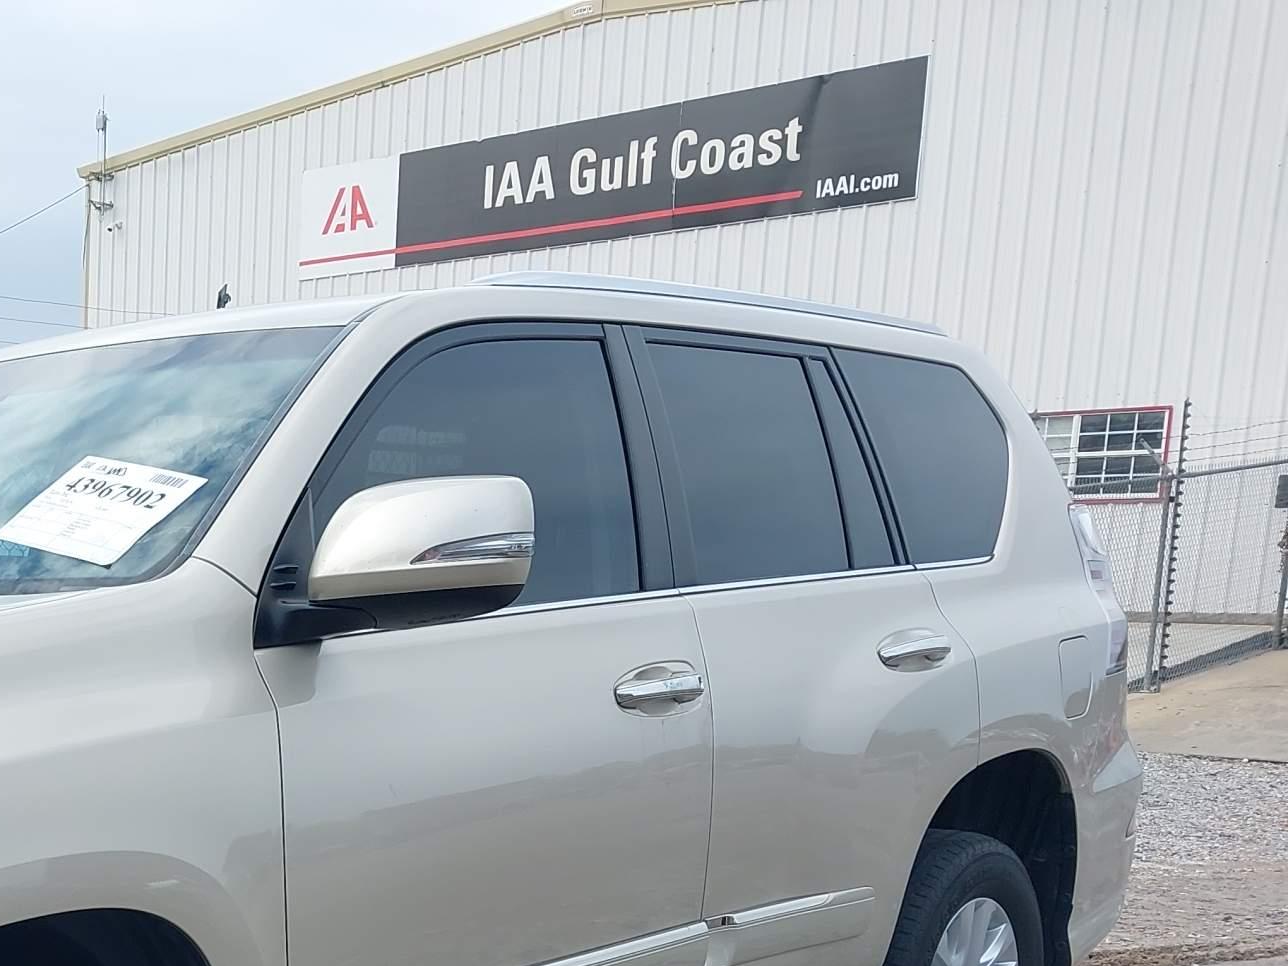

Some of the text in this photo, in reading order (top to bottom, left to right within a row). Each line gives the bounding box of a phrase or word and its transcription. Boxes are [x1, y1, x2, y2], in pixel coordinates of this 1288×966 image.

[483, 116, 803, 209] IAA Gulf Coast
[815, 169, 899, 199] IAAI.com
[65, 476, 166, 509] 43967902
